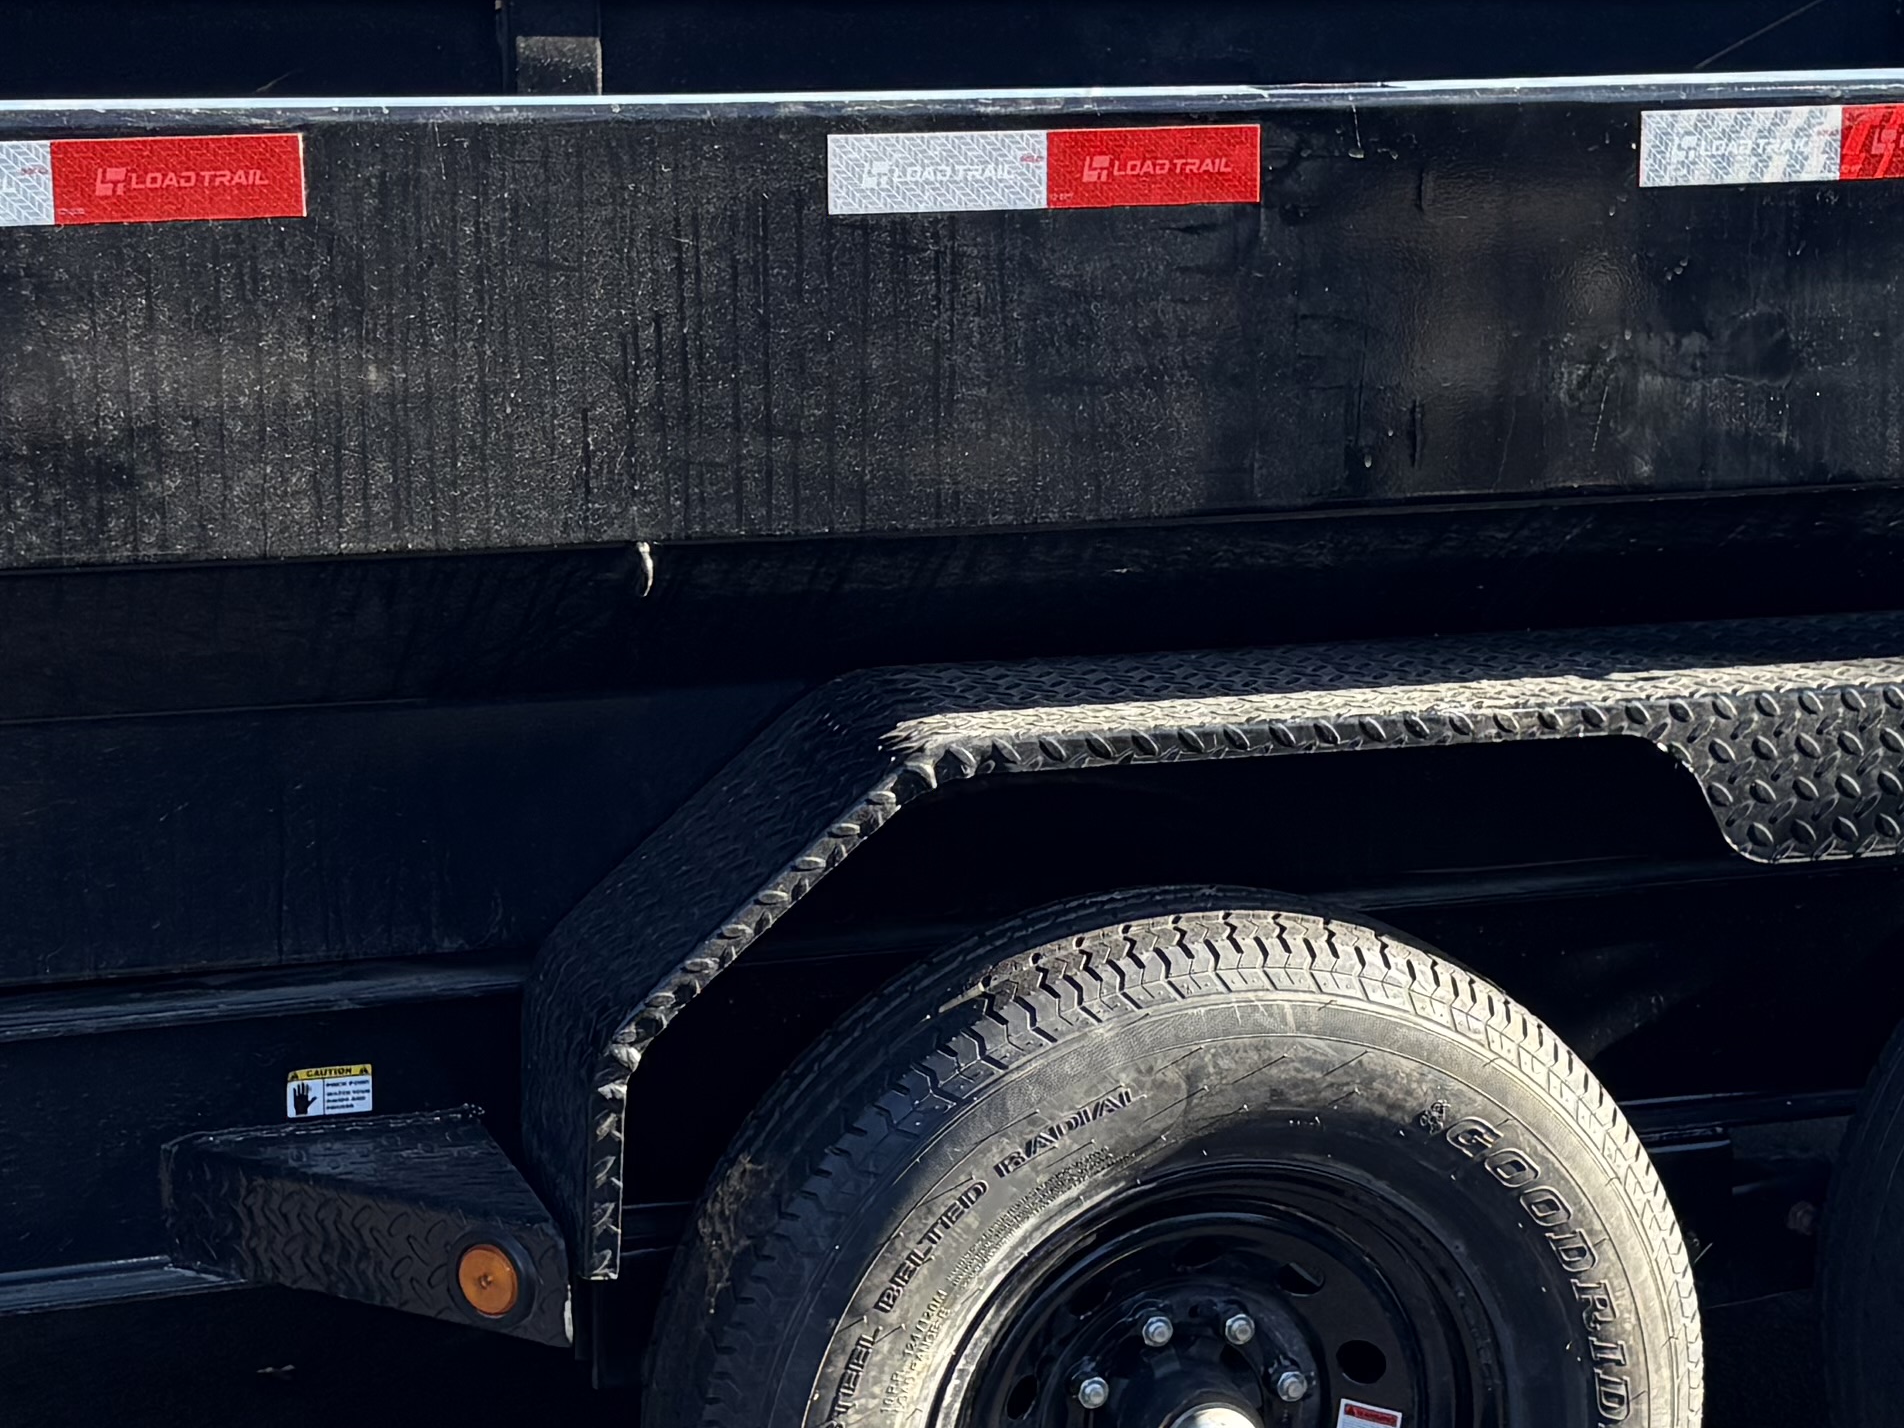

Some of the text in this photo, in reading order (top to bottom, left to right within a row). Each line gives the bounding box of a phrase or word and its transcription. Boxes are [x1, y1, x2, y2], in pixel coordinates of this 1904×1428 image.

[1113, 156, 1232, 177] LOAD TRAIL
[130, 169, 269, 189] LOAD TRAIL
[874, 1179, 988, 1314] BELTED
[994, 1089, 1146, 1179] RADIAL
